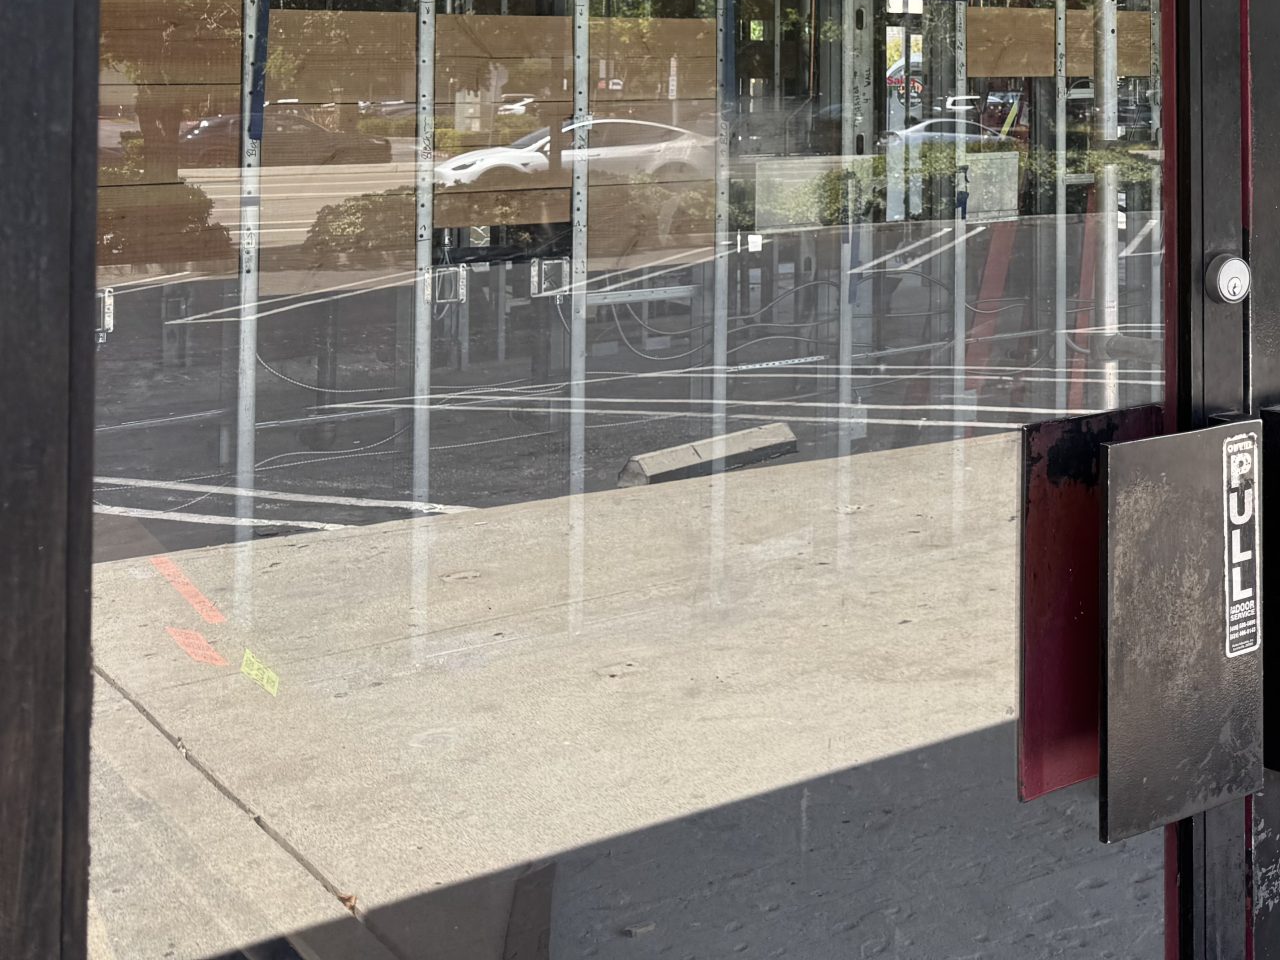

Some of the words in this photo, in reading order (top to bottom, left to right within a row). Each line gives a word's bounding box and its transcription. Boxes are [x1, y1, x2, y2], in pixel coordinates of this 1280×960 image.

[1229, 452, 1253, 602] PULL
[1235, 600, 1255, 614] DOOR
[1230, 608, 1256, 622] SERVICE
